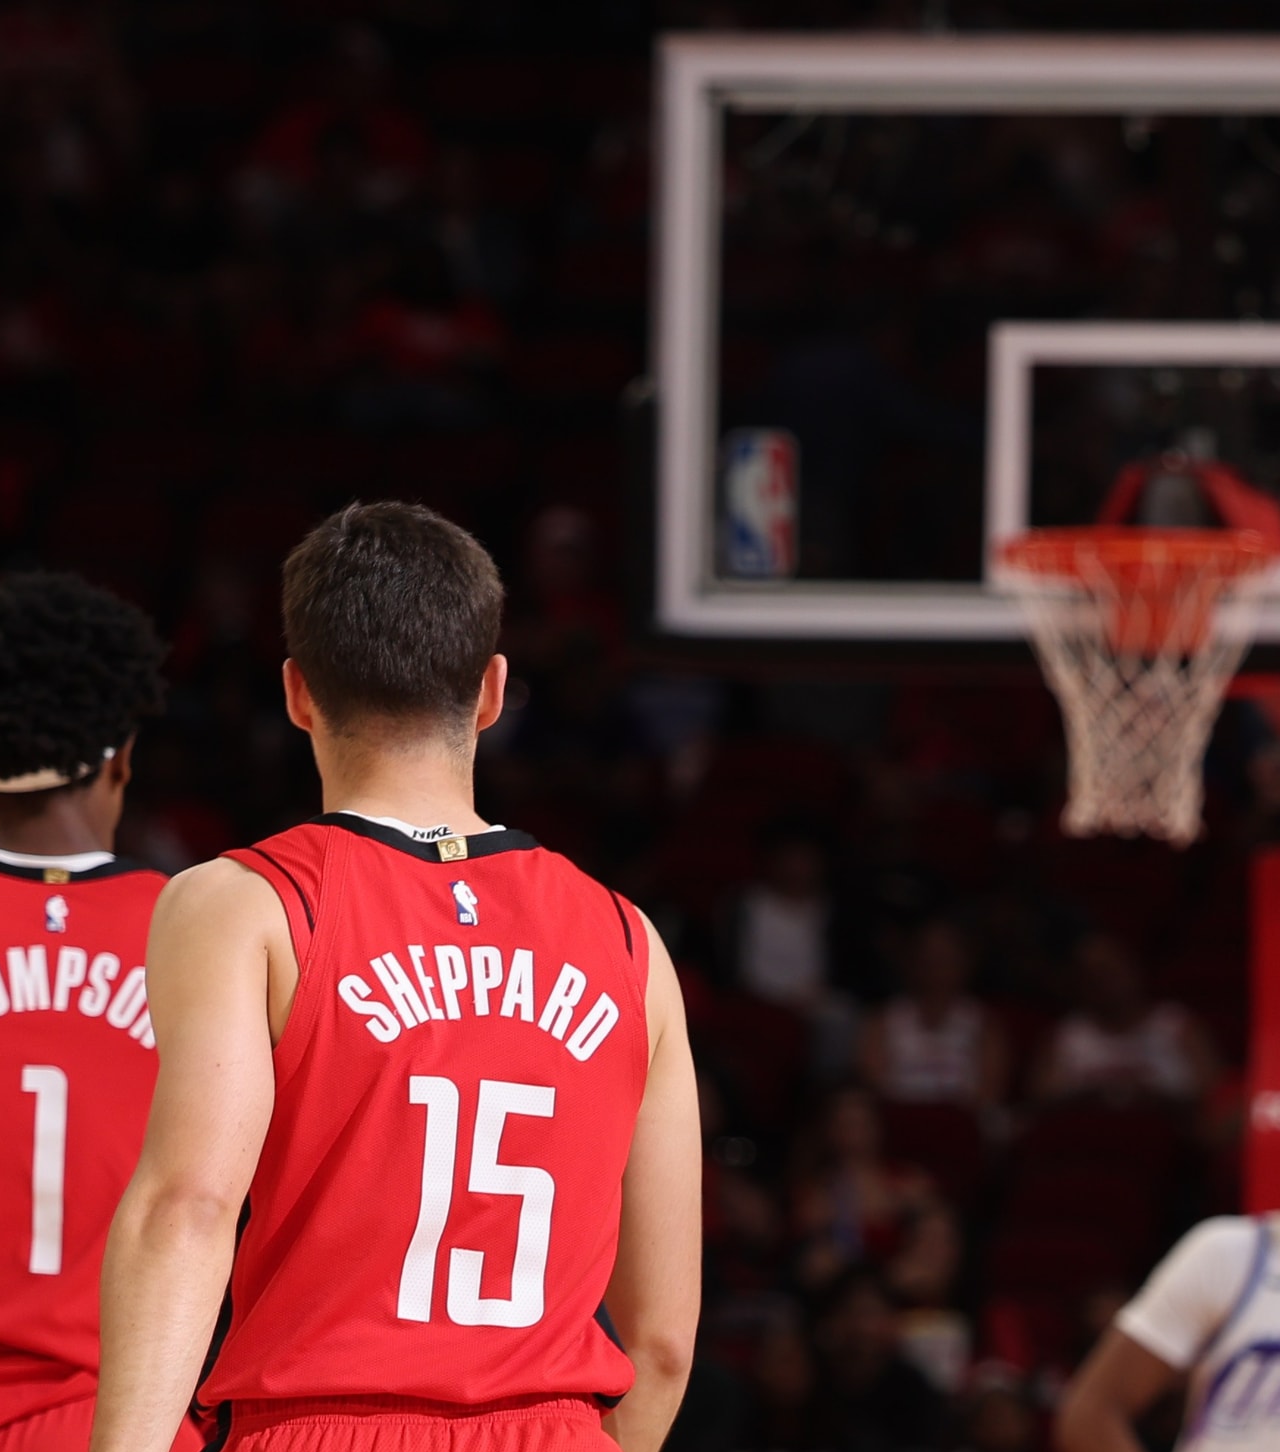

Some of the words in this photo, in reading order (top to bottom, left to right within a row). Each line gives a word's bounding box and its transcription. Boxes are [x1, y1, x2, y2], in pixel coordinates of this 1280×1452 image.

[337, 944, 620, 1063] SHEPPARD
[21, 1064, 69, 1276] 1
[396, 1075, 556, 1329] 15
